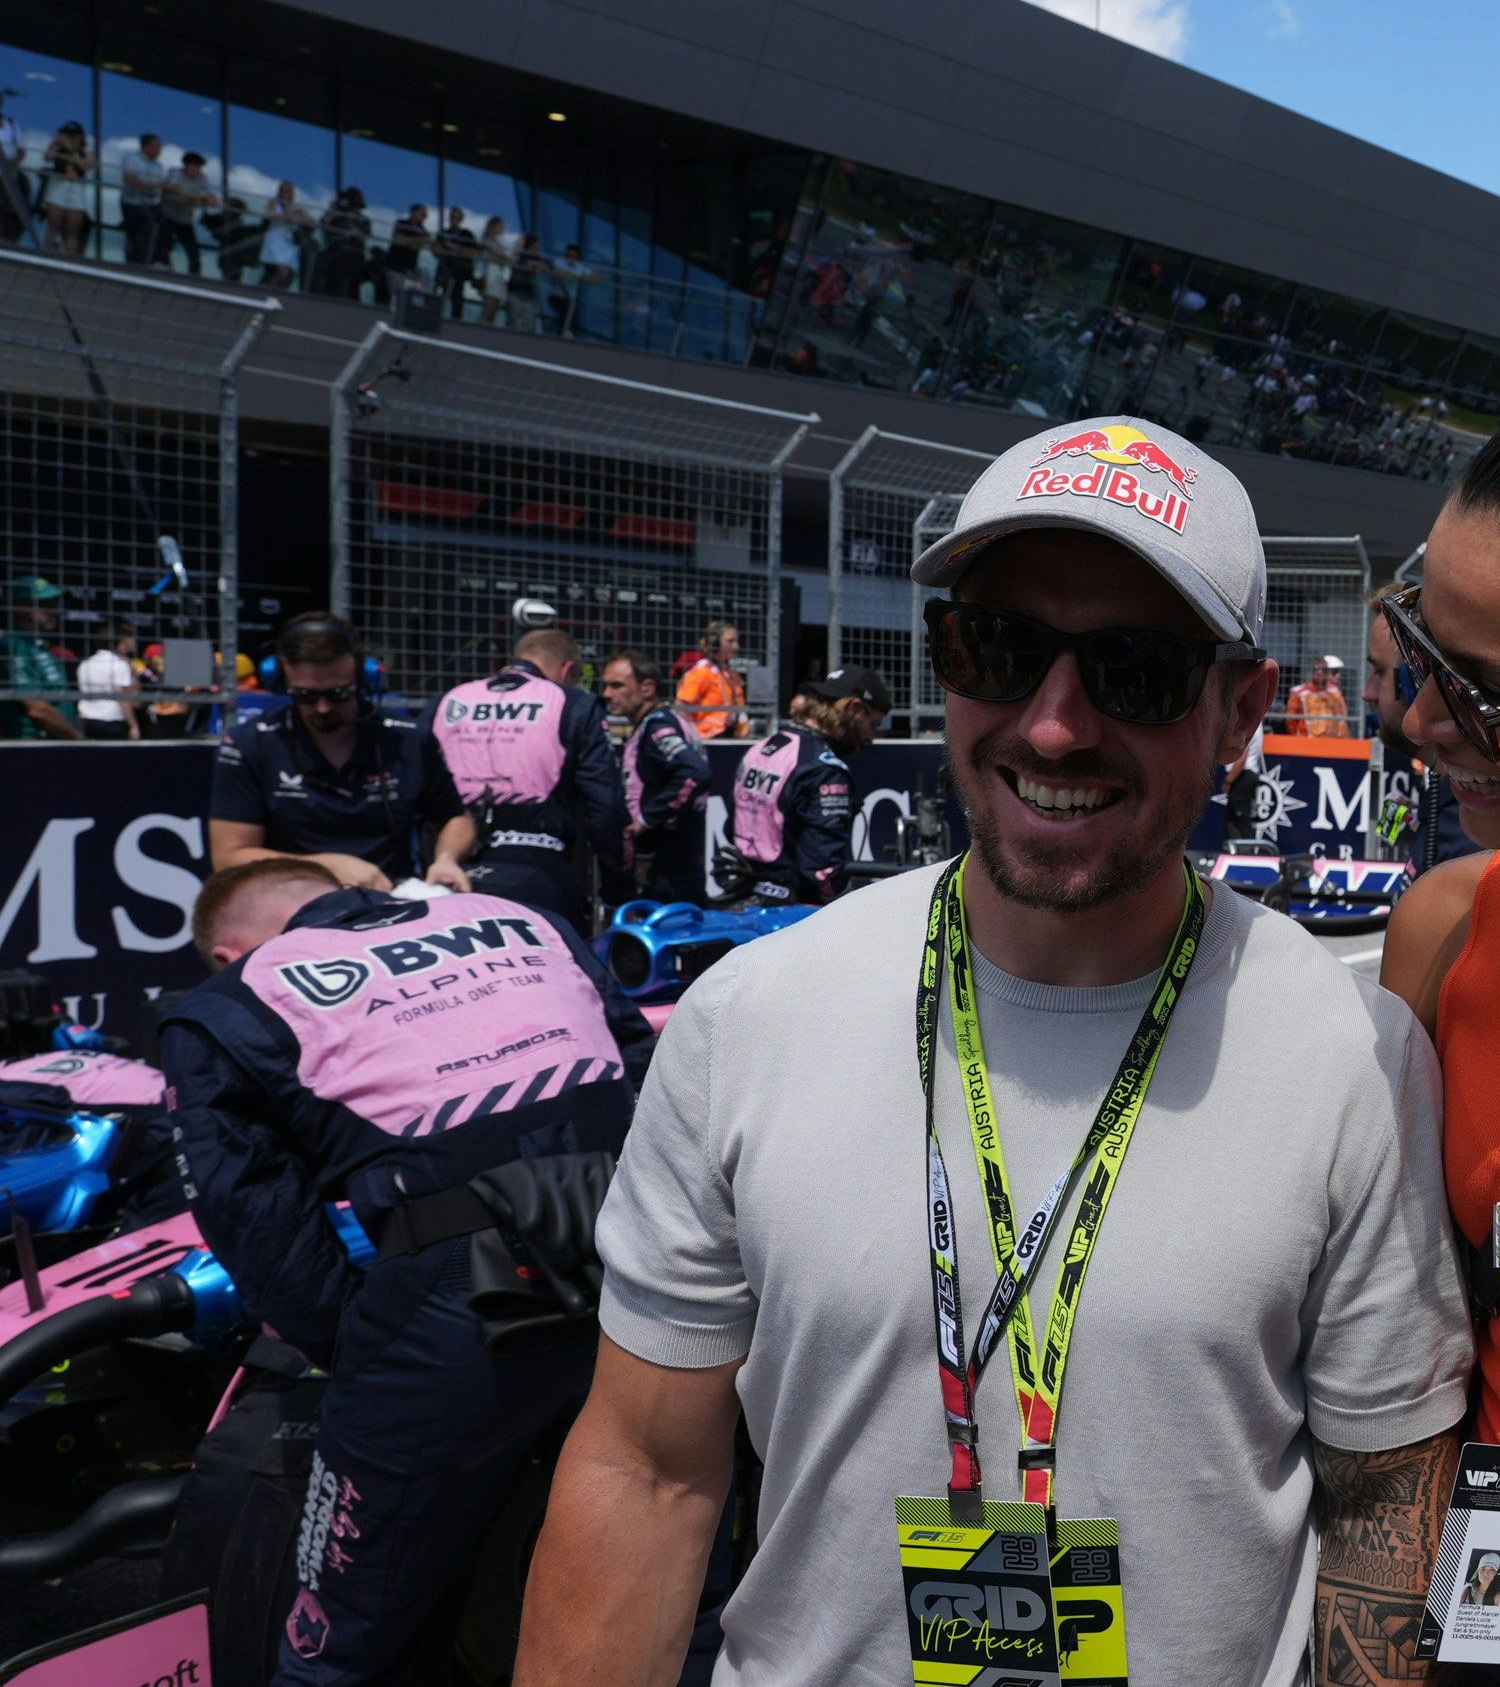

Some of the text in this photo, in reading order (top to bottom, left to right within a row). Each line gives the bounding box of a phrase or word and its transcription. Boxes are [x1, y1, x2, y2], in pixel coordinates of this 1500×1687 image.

[1018, 463, 1189, 533] Red Bull
[473, 703, 543, 721] BWT
[370, 916, 545, 977] BWT
[1172, 936, 1197, 980] GRID
[365, 955, 547, 1016] ALPINE
[393, 997, 464, 1027] FORMULA
[511, 972, 545, 988] TEAM
[972, 1062, 997, 1150] AUSTRIA
[1089, 1066, 1140, 1148] AUSTRIA
[933, 1199, 950, 1252] GRID
[1016, 1210, 1048, 1259] GRID
[1064, 1226, 1092, 1266] VIP
[1465, 1469, 1499, 1488] VIP
[910, 1580, 1048, 1633] GRID
[920, 1613, 1045, 1661] VIP Access
